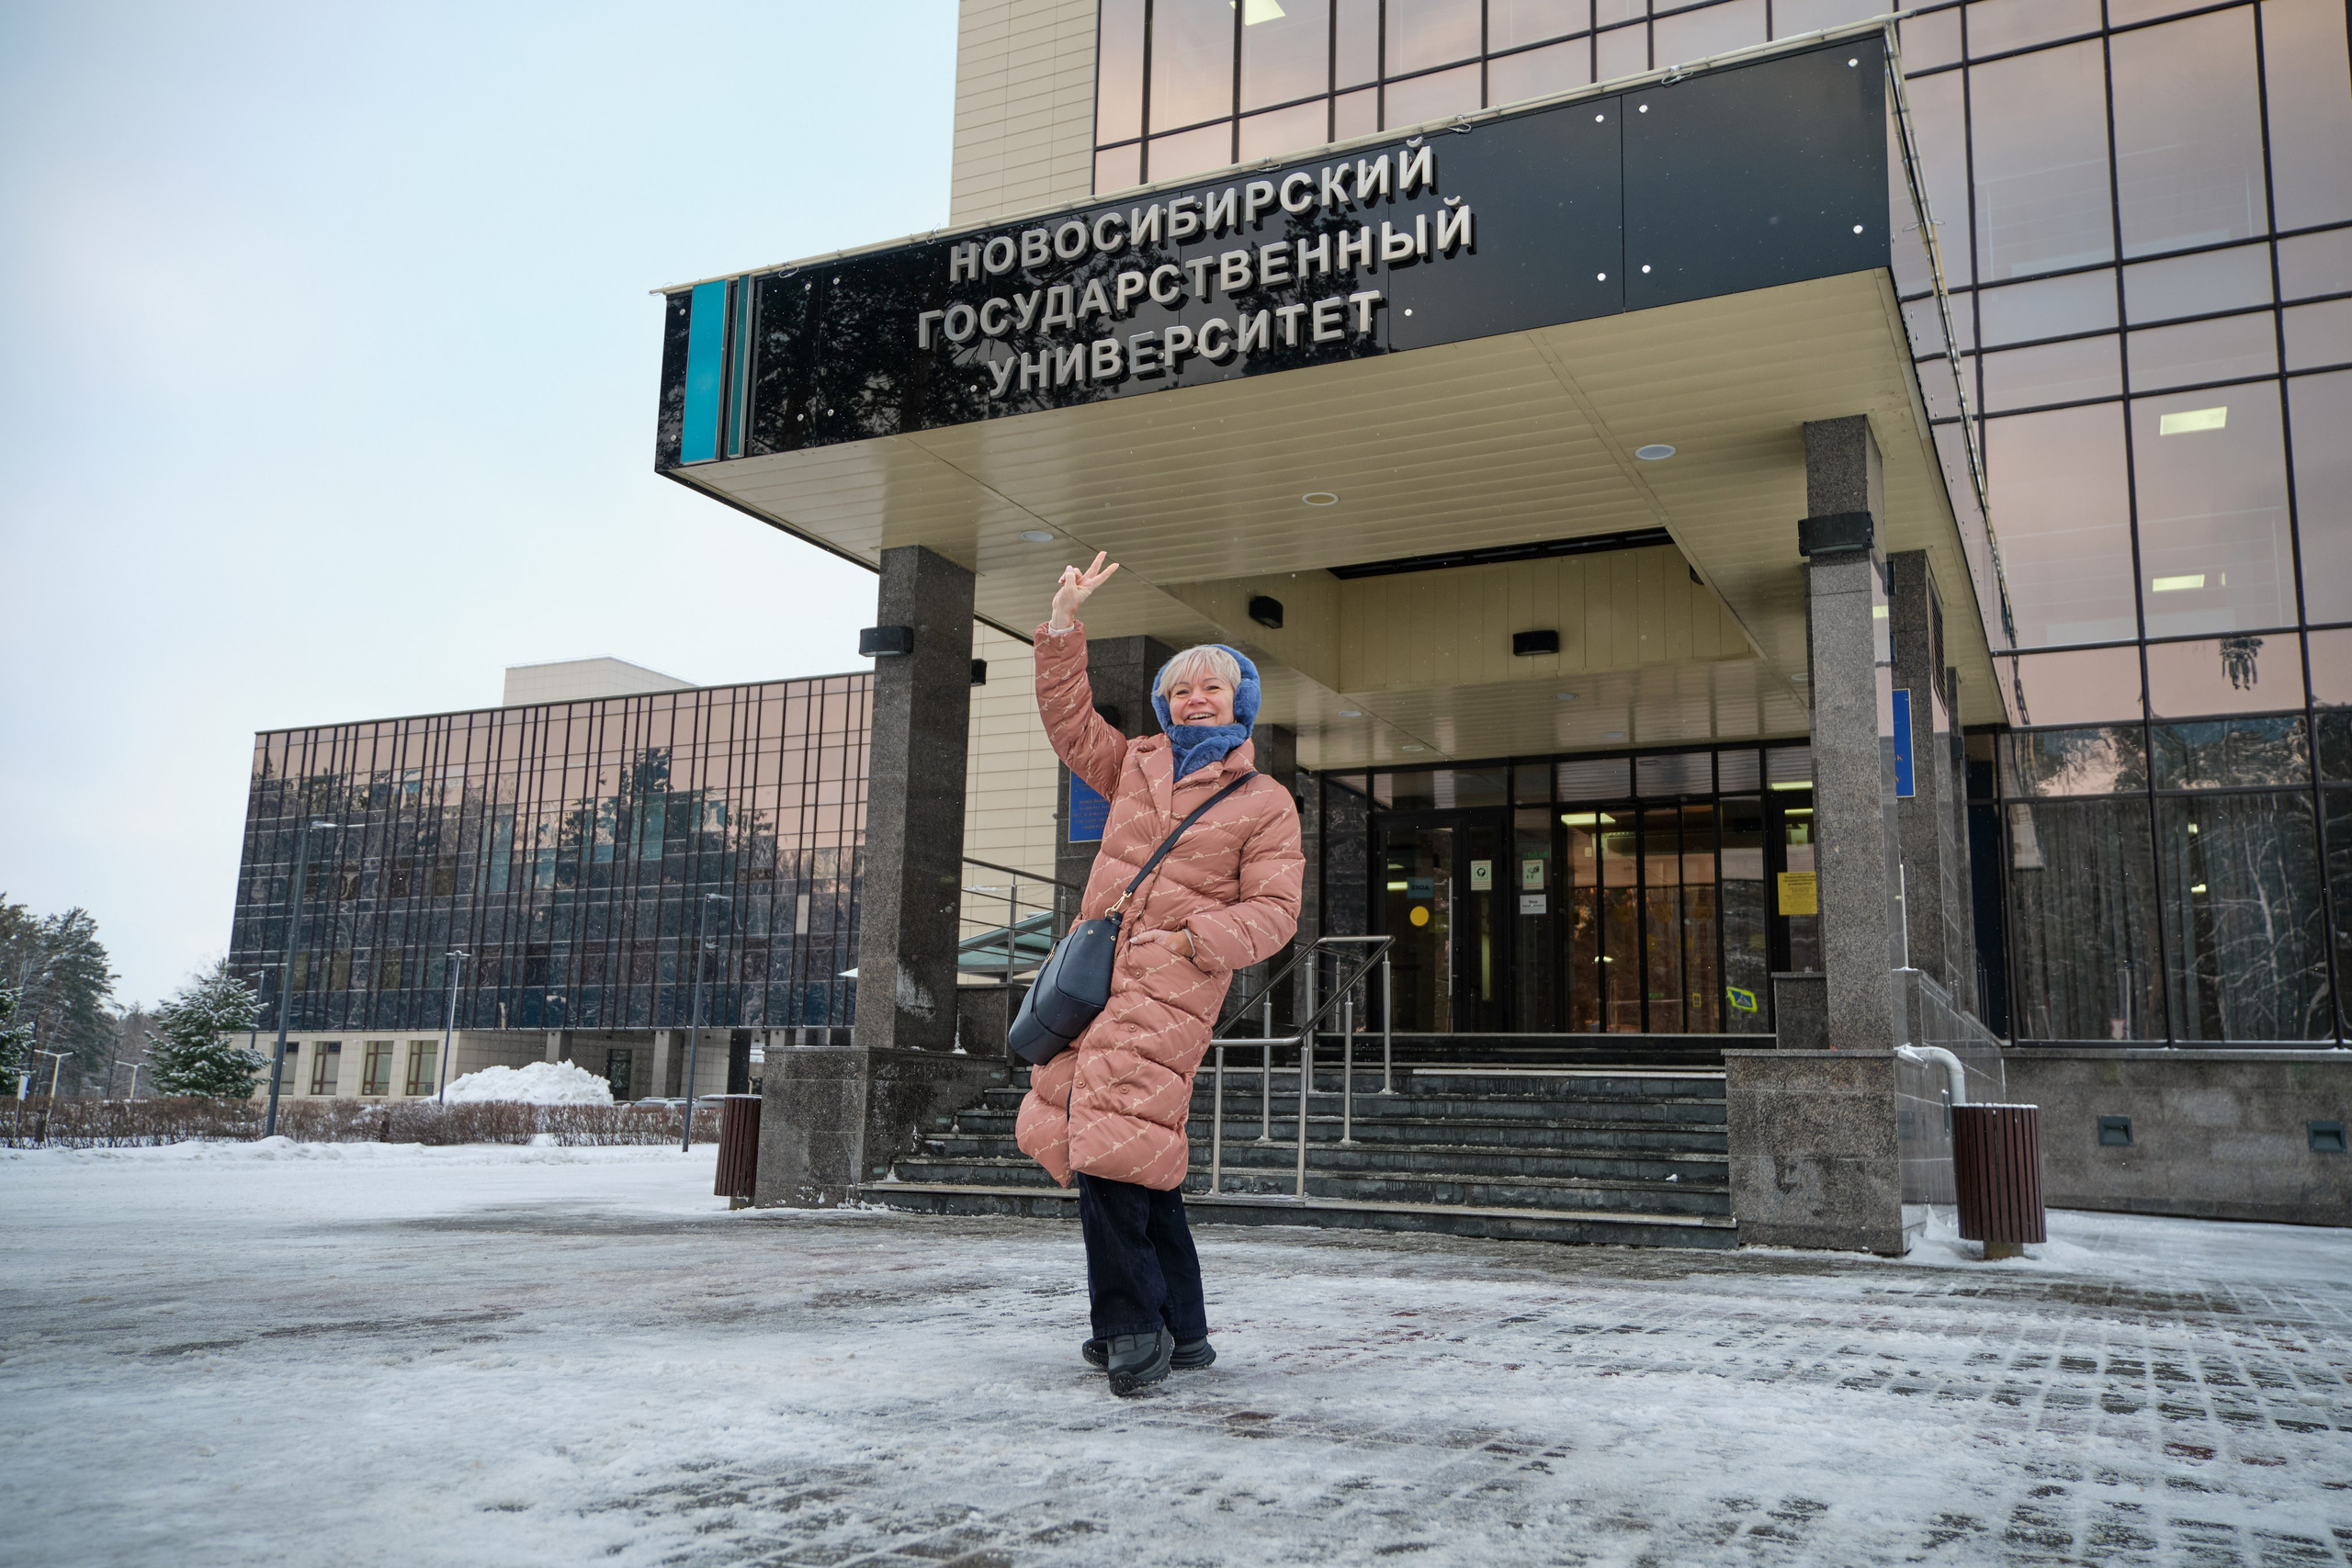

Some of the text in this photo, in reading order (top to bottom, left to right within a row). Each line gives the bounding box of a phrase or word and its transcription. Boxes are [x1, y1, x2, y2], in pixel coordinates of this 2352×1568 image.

[918, 196, 1473, 350] ГОСУДАРСТВЕННЫЙ
[949, 136, 1436, 283] НОВОСИБИРСКИЙ
[988, 289, 1383, 399] УНИВЕРСИТЕТ
